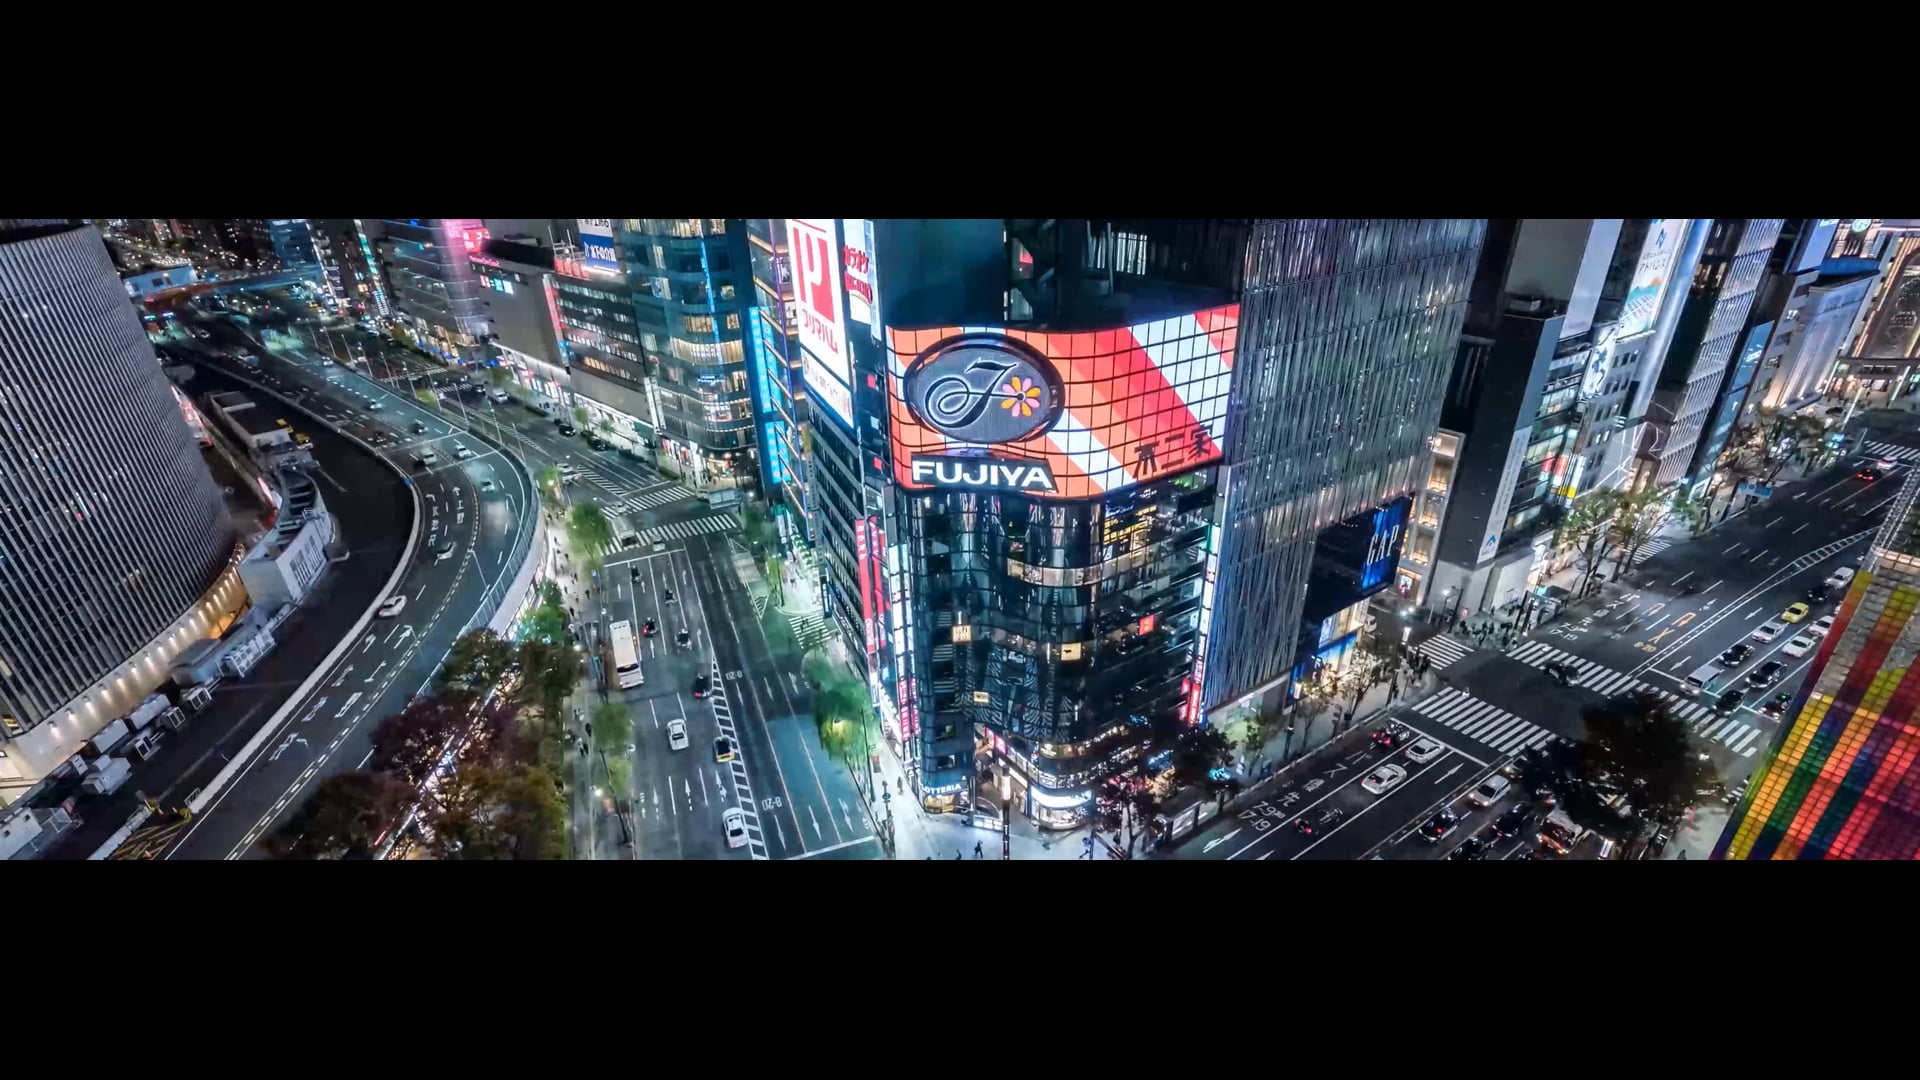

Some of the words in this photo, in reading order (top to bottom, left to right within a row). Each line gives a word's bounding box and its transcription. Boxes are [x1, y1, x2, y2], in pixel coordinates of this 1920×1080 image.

[1132, 424, 1213, 479] 不二家
[911, 460, 1053, 489] FUJIYA
[1367, 525, 1399, 565] GAP
[1238, 809, 1271, 831] 17-19
